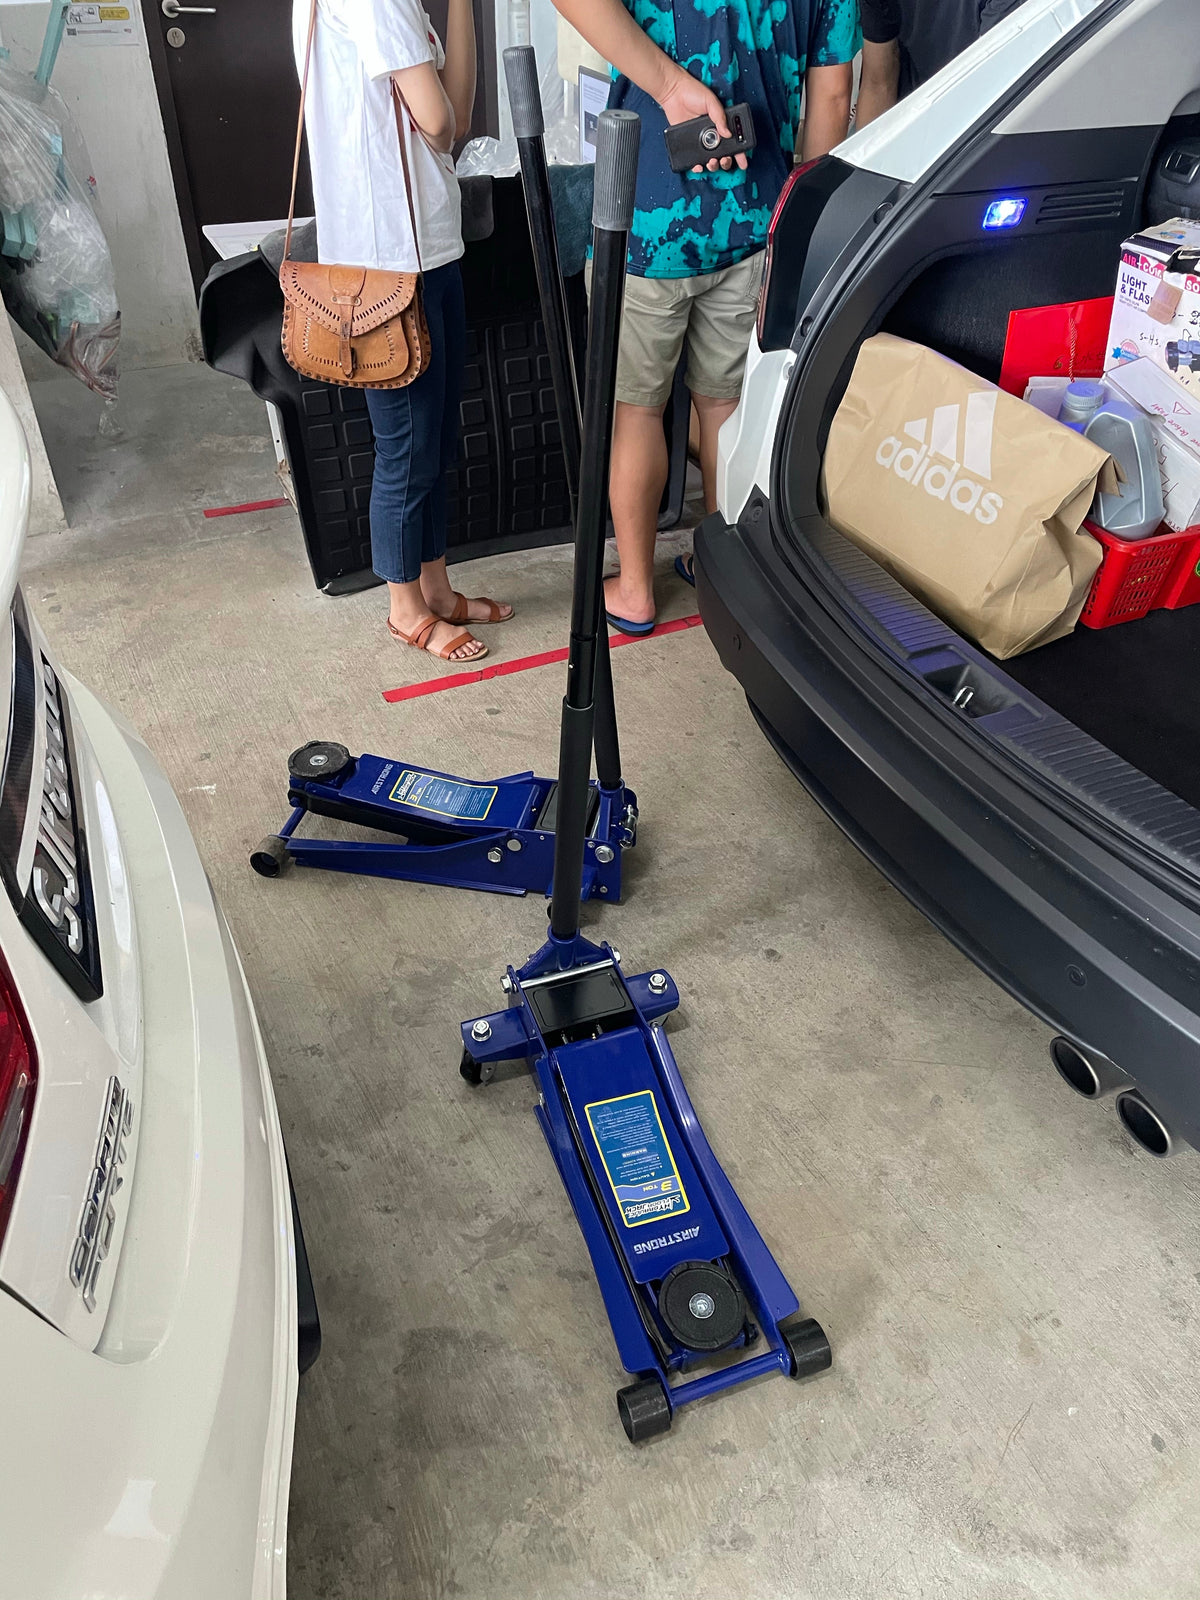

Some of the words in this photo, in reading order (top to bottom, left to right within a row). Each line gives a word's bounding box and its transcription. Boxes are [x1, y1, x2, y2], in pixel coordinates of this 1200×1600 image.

[1120, 284, 1126, 294] &
[1122, 273, 1147, 292] LIGHT
[876, 436, 1003, 524] adidas
[371, 764, 394, 795] AIRSTRONG
[661, 1180, 672, 1190] 3
[633, 1225, 700, 1255] AIRSTRONG
